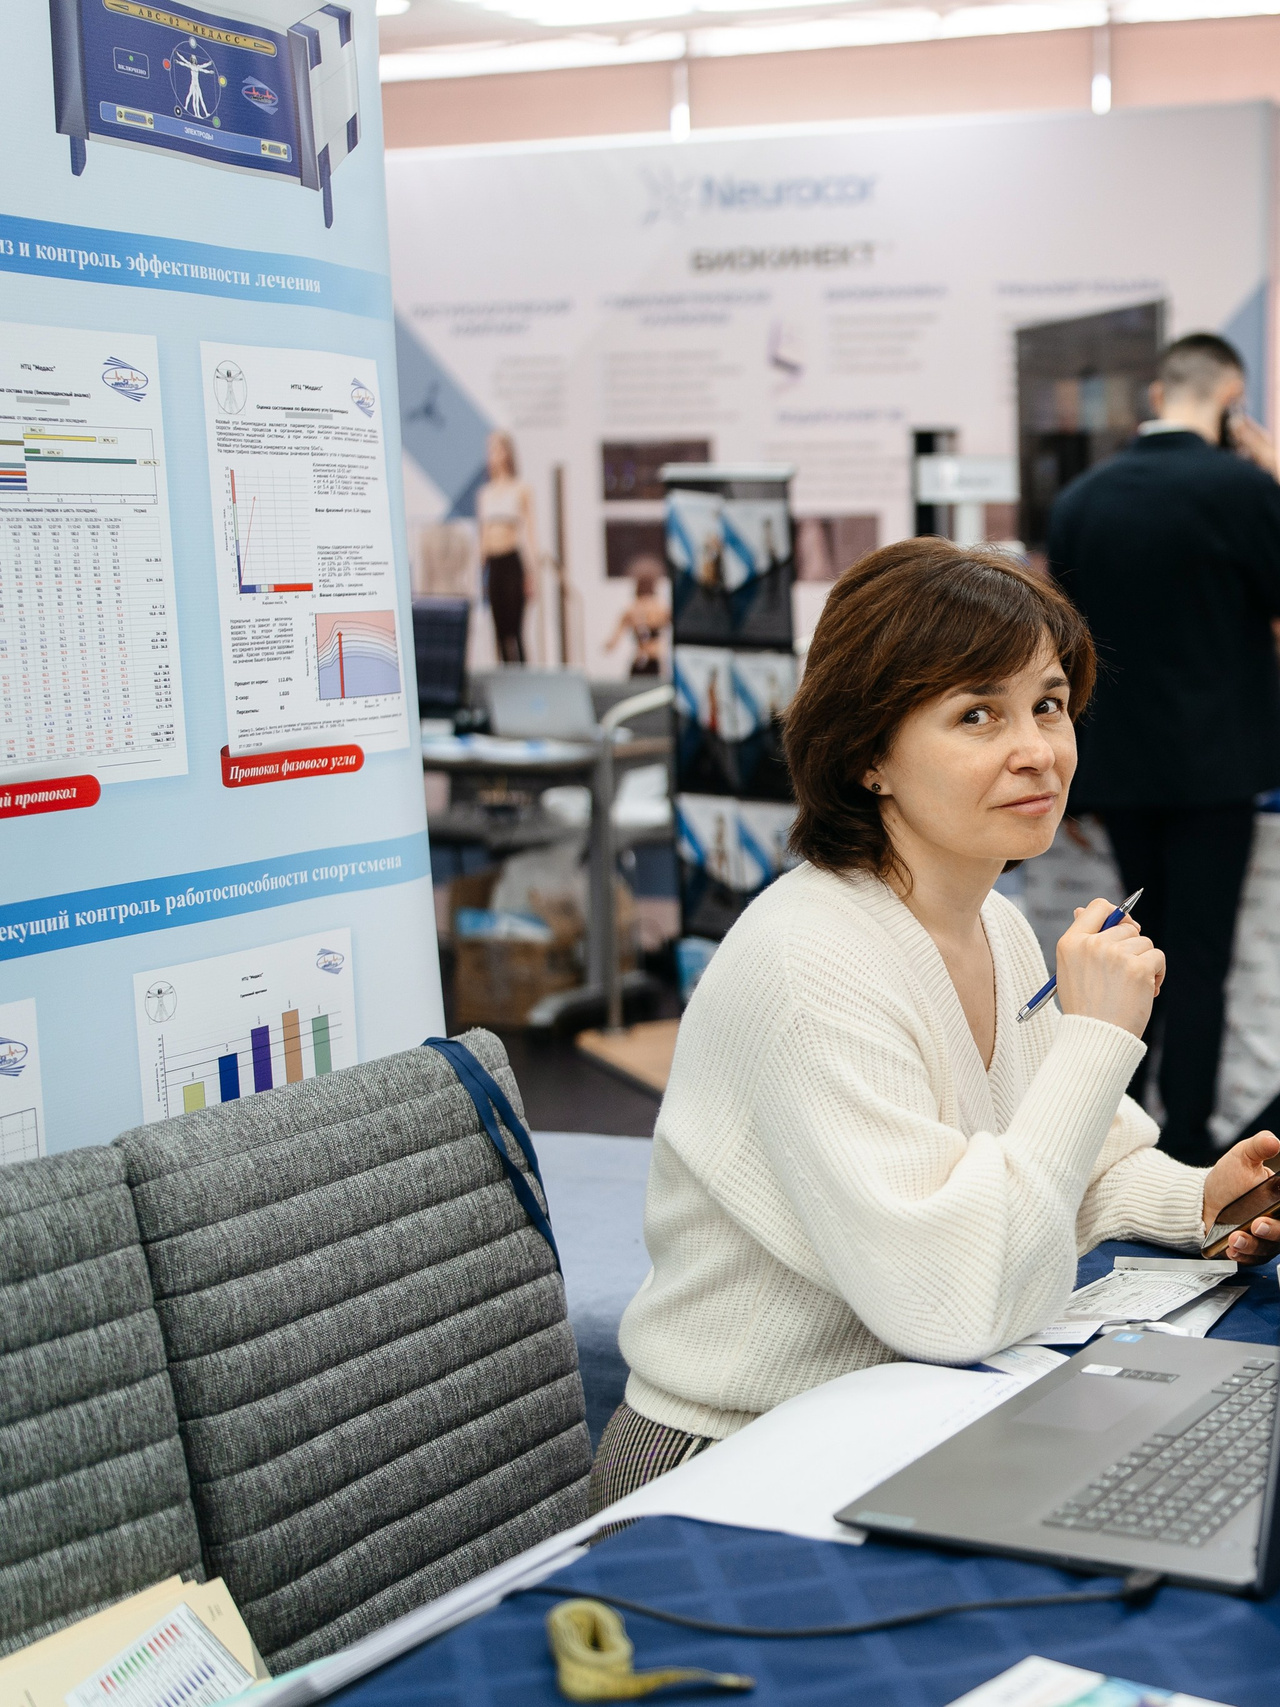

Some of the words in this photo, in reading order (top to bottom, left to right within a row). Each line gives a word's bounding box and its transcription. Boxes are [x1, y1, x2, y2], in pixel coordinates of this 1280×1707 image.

[184, 126, 214, 141] ЭЛЕКТРОДЫ
[700, 174, 876, 208] Neurocor
[19, 241, 30, 257] и
[35, 243, 122, 270] контроль
[126, 252, 251, 286] эффективности
[255, 273, 321, 294] лечения
[229, 763, 279, 782] Протокол
[281, 760, 328, 776] фазового
[330, 754, 357, 770] угла
[14, 788, 77, 809] протокол
[75, 899, 160, 924] контроль
[165, 868, 308, 916] работоспособности
[312, 852, 402, 886] спортсмена
